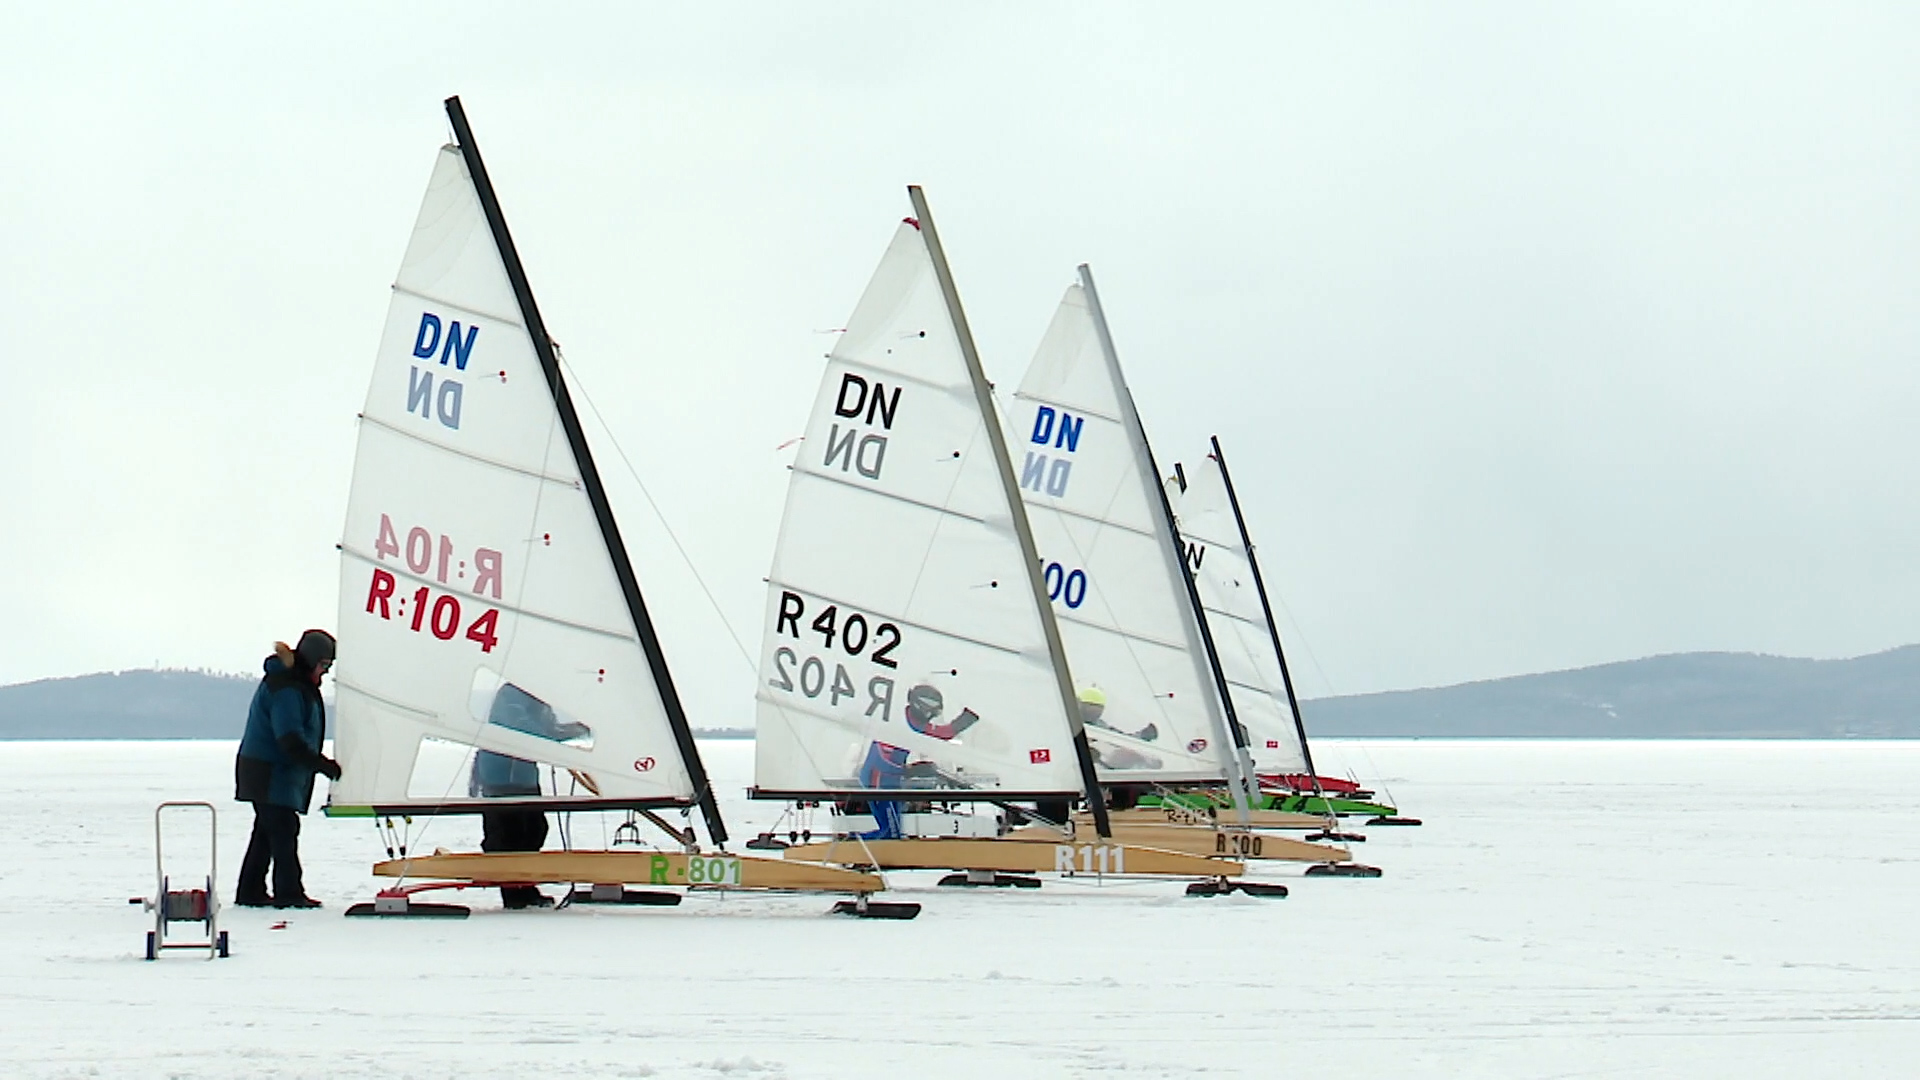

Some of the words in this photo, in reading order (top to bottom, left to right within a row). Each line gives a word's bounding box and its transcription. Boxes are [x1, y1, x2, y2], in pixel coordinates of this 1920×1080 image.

[412, 312, 479, 371] DN
[835, 373, 902, 430] DN
[1031, 406, 1084, 452] DN
[1040, 558, 1087, 609] 00
